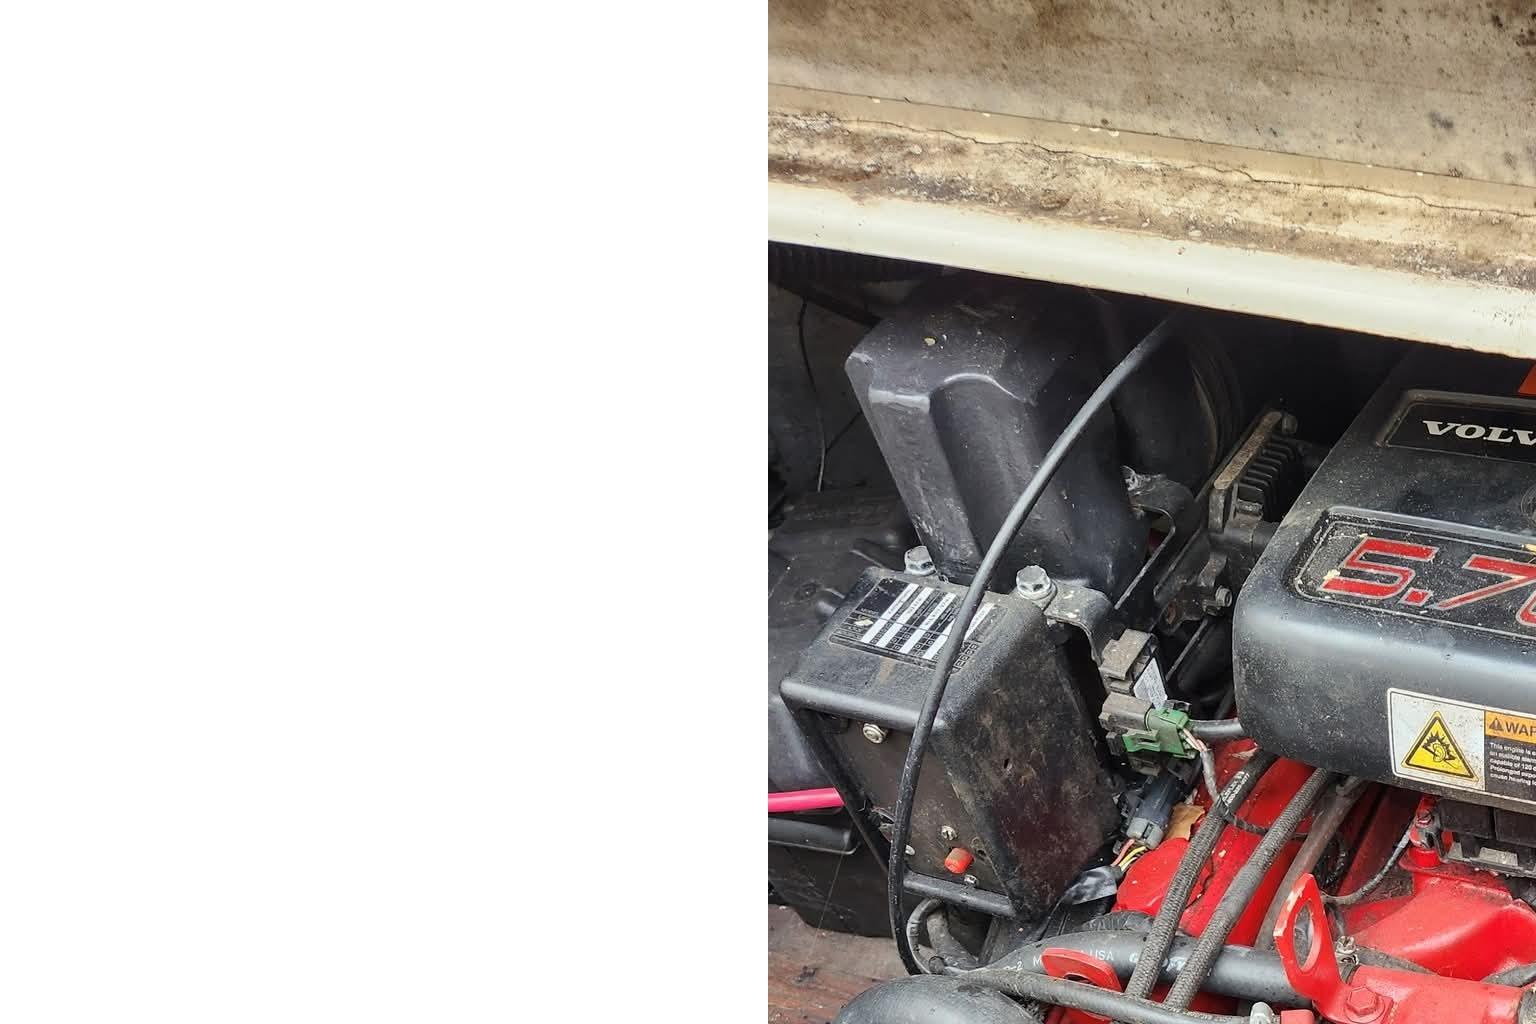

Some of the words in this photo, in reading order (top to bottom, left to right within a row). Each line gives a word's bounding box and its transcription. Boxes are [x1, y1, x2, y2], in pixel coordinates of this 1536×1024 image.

[1490, 742, 1503, 750] This
[1504, 745, 1524, 753] engine
[1490, 758, 1513, 767] capable
[1490, 765, 1520, 775] Prolonged
[1509, 776, 1531, 784] hearing
